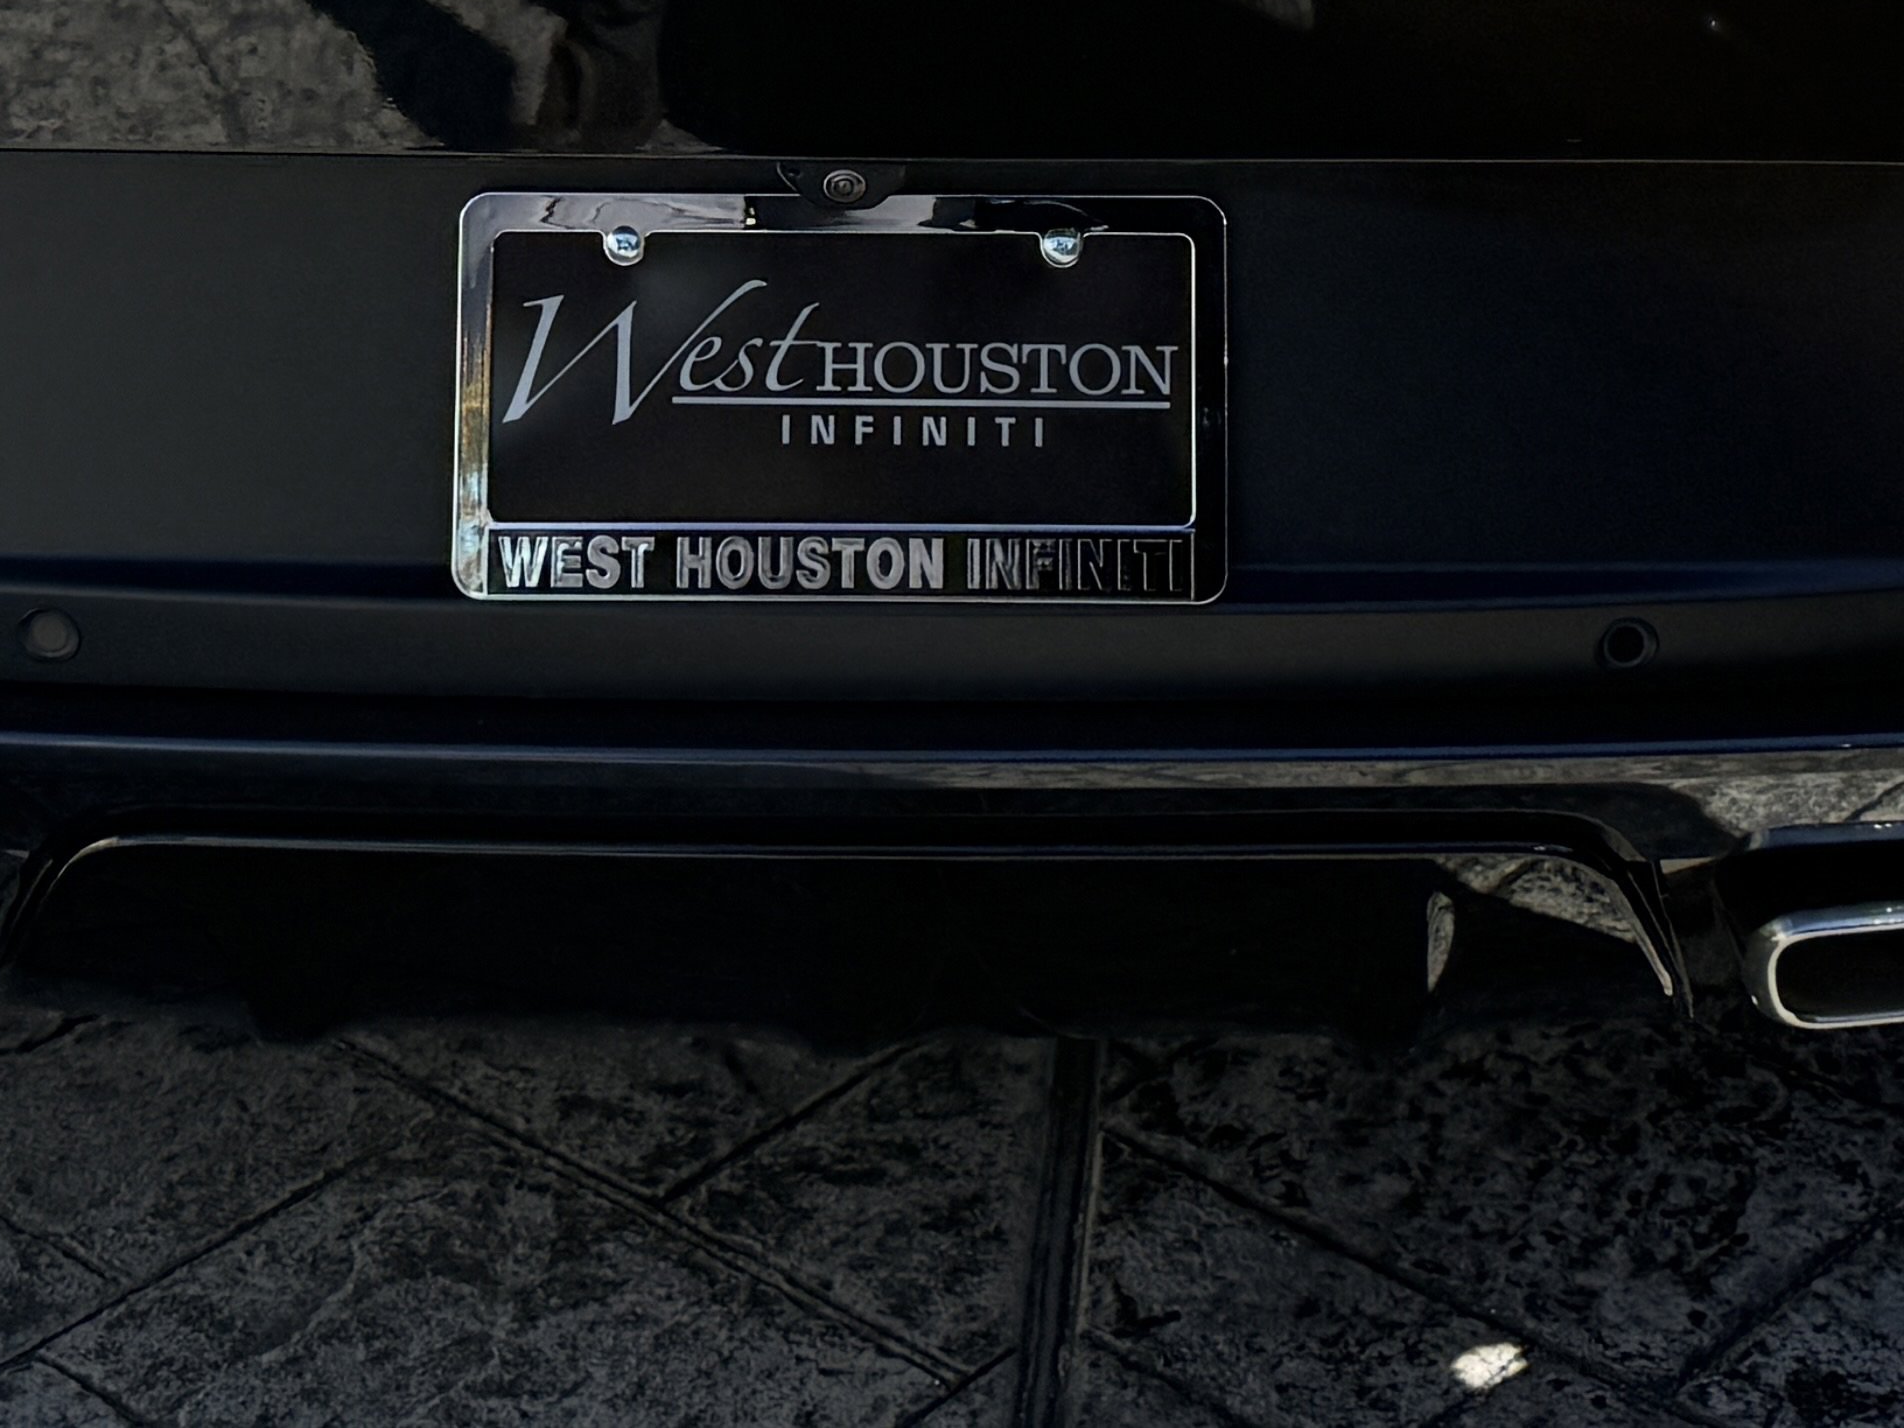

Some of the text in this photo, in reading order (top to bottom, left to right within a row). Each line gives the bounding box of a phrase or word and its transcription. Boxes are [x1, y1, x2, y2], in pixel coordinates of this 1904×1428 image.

[502, 279, 1179, 425] West HOUSTON
[782, 414, 1044, 448] INFINITI
[498, 535, 1184, 592] WEST HOUSTON INFINITI
